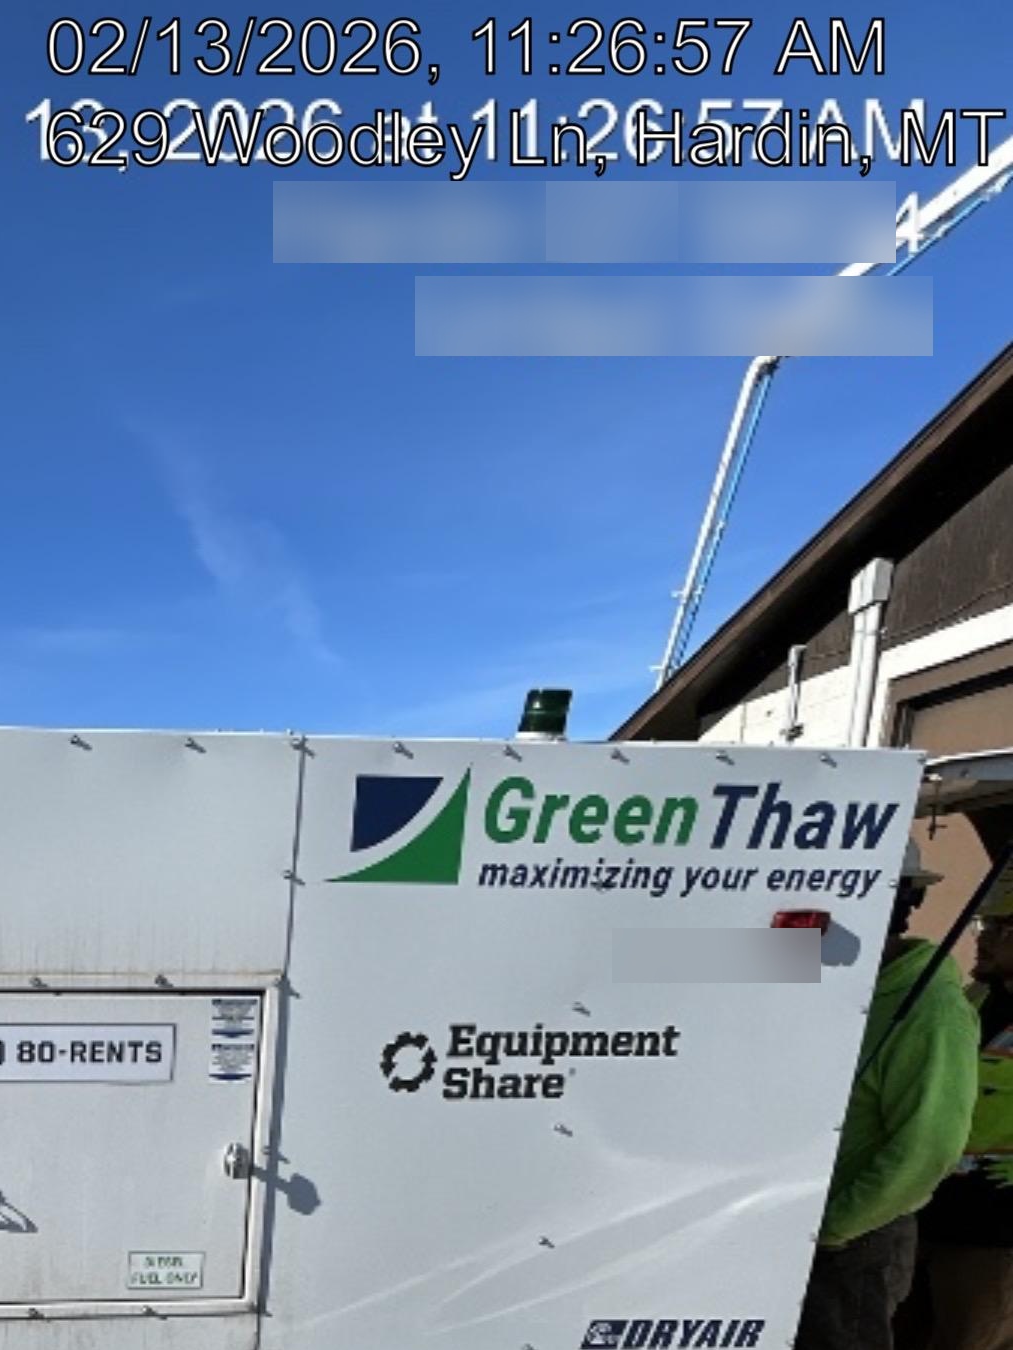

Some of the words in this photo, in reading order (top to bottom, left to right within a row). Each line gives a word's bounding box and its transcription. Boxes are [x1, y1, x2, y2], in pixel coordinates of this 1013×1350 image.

[478, 857, 675, 899] maximizing
[680, 865, 759, 898] your
[766, 866, 882, 900] energy
[16, 1040, 163, 1064] 80-RENTS
[446, 1023, 682, 1066] Equipment
[442, 1067, 566, 1099] Share
[620, 1319, 766, 1350] DRYAIR
